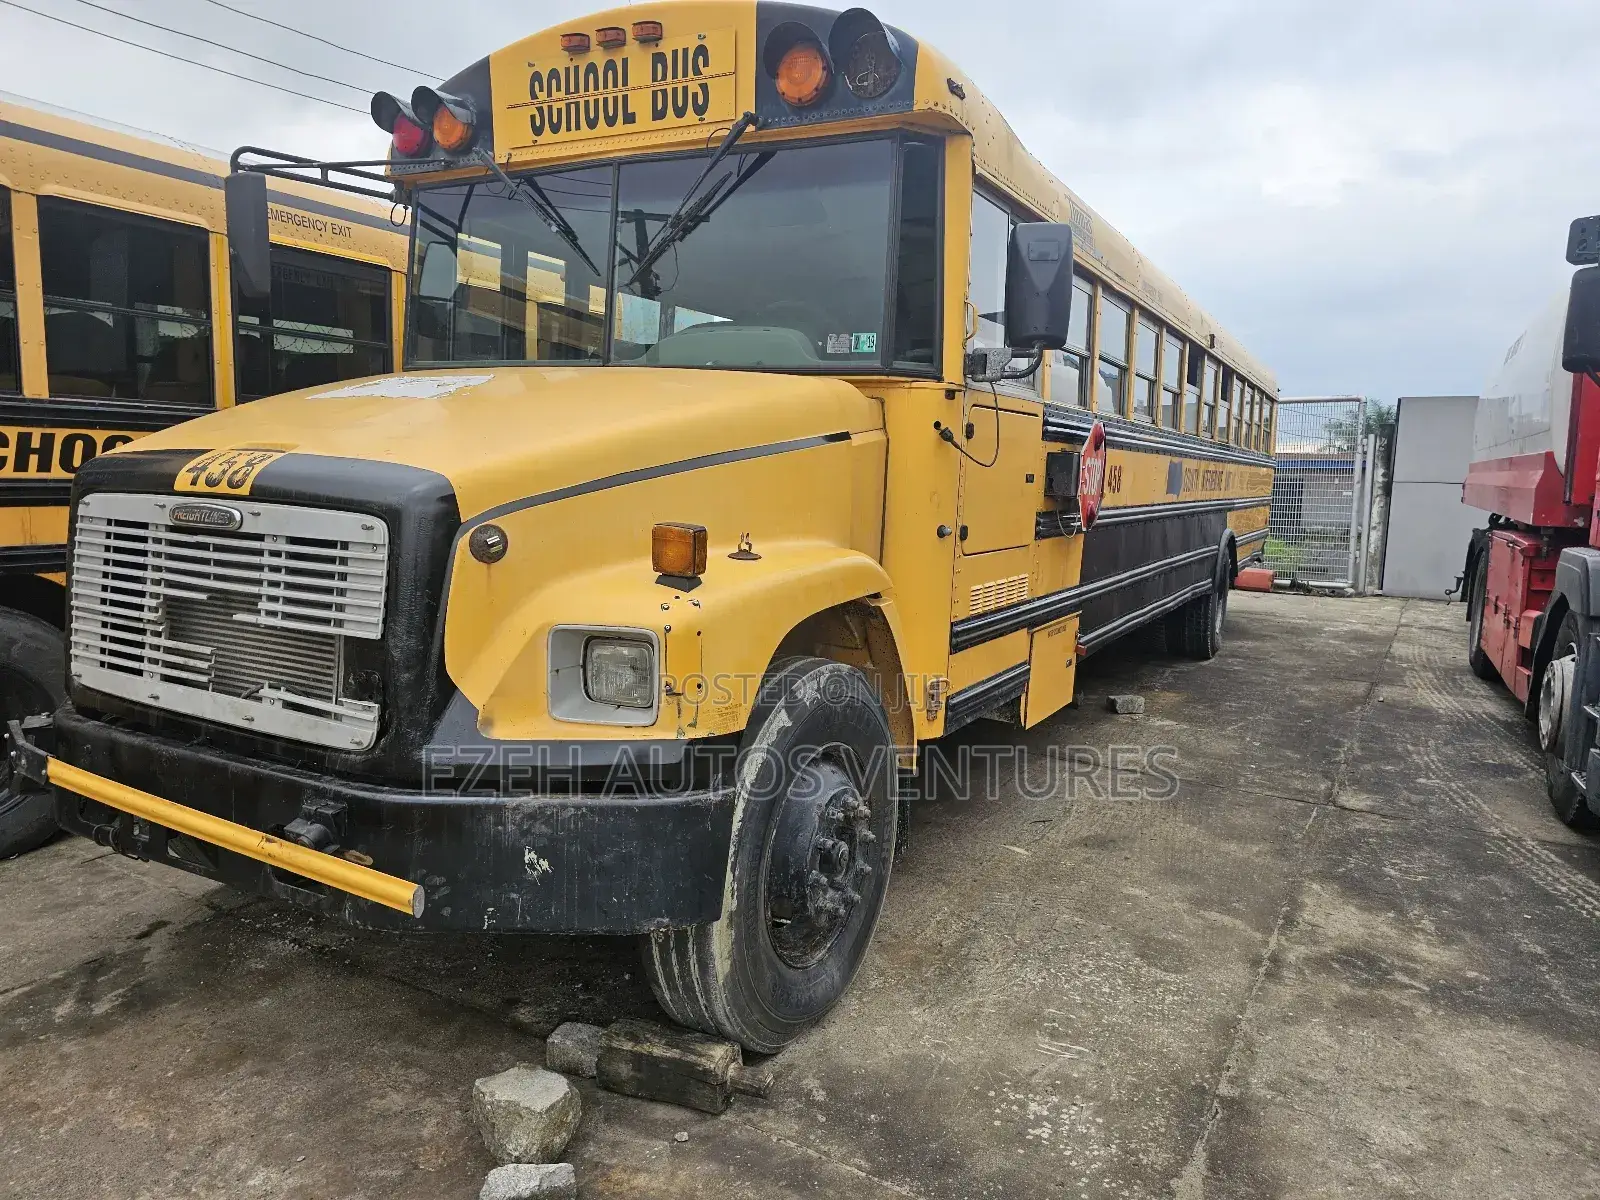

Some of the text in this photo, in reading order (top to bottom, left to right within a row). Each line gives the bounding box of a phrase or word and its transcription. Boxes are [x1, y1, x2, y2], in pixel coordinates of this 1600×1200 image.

[529, 43, 710, 137] SCHOOL BUS
[331, 223, 352, 239] EXIT
[0, 431, 135, 474] HO
[1083, 456, 1102, 496] STOP
[1107, 464, 1122, 495] 458
